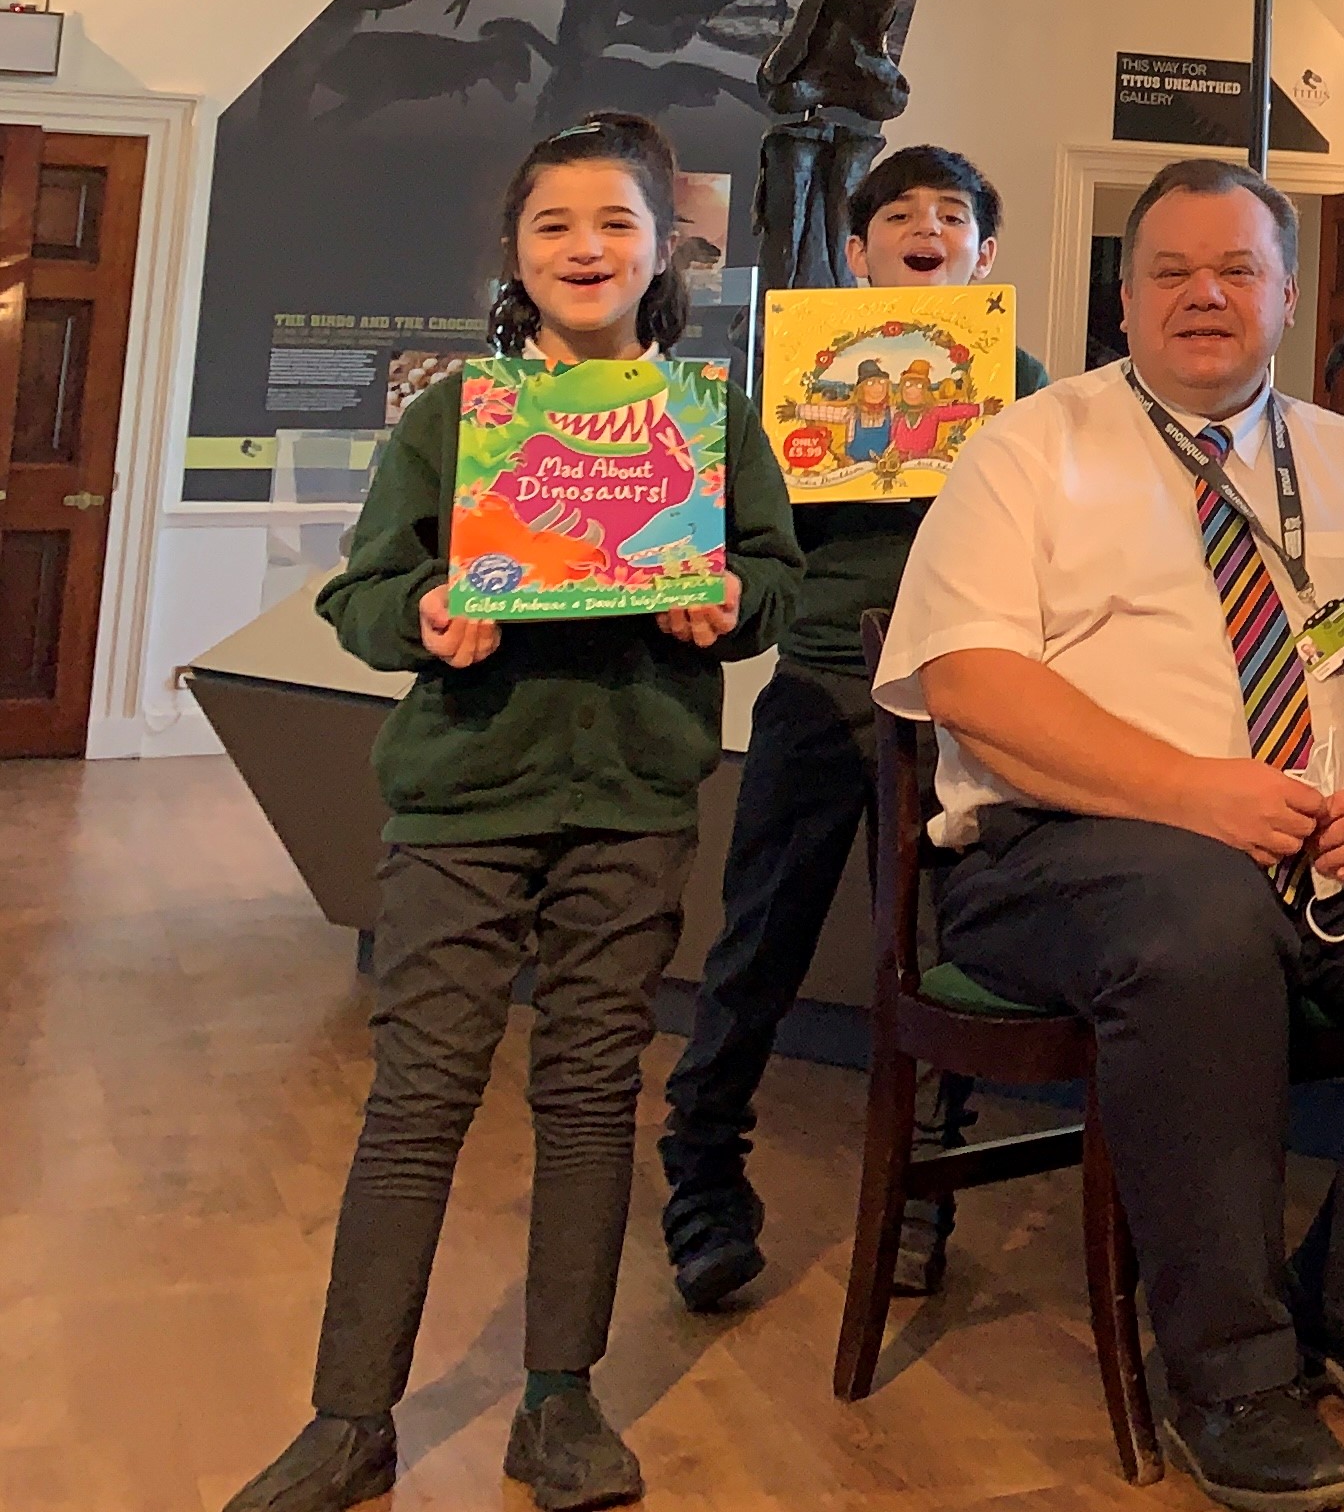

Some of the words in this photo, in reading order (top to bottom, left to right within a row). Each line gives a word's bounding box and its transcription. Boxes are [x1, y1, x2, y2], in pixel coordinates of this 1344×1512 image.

[1121, 58, 1149, 72] THIS
[1152, 60, 1180, 73] WAY
[1182, 63, 1208, 76] FOR
[1120, 74, 1160, 88] TITUS
[1164, 76, 1241, 95] UNEARTHED
[1119, 90, 1174, 106] GALLERY
[274, 313, 305, 327] THE
[360, 316, 390, 329] AND
[791, 437, 820, 447] ONLY
[1164, 422, 1210, 466] ambitious
[788, 447, 823, 458] £5.99
[535, 455, 585, 479] Mad
[588, 457, 654, 480] About
[515, 476, 669, 504] Dinosaurs!
[464, 596, 506, 613] Giles
[585, 593, 626, 611] David
